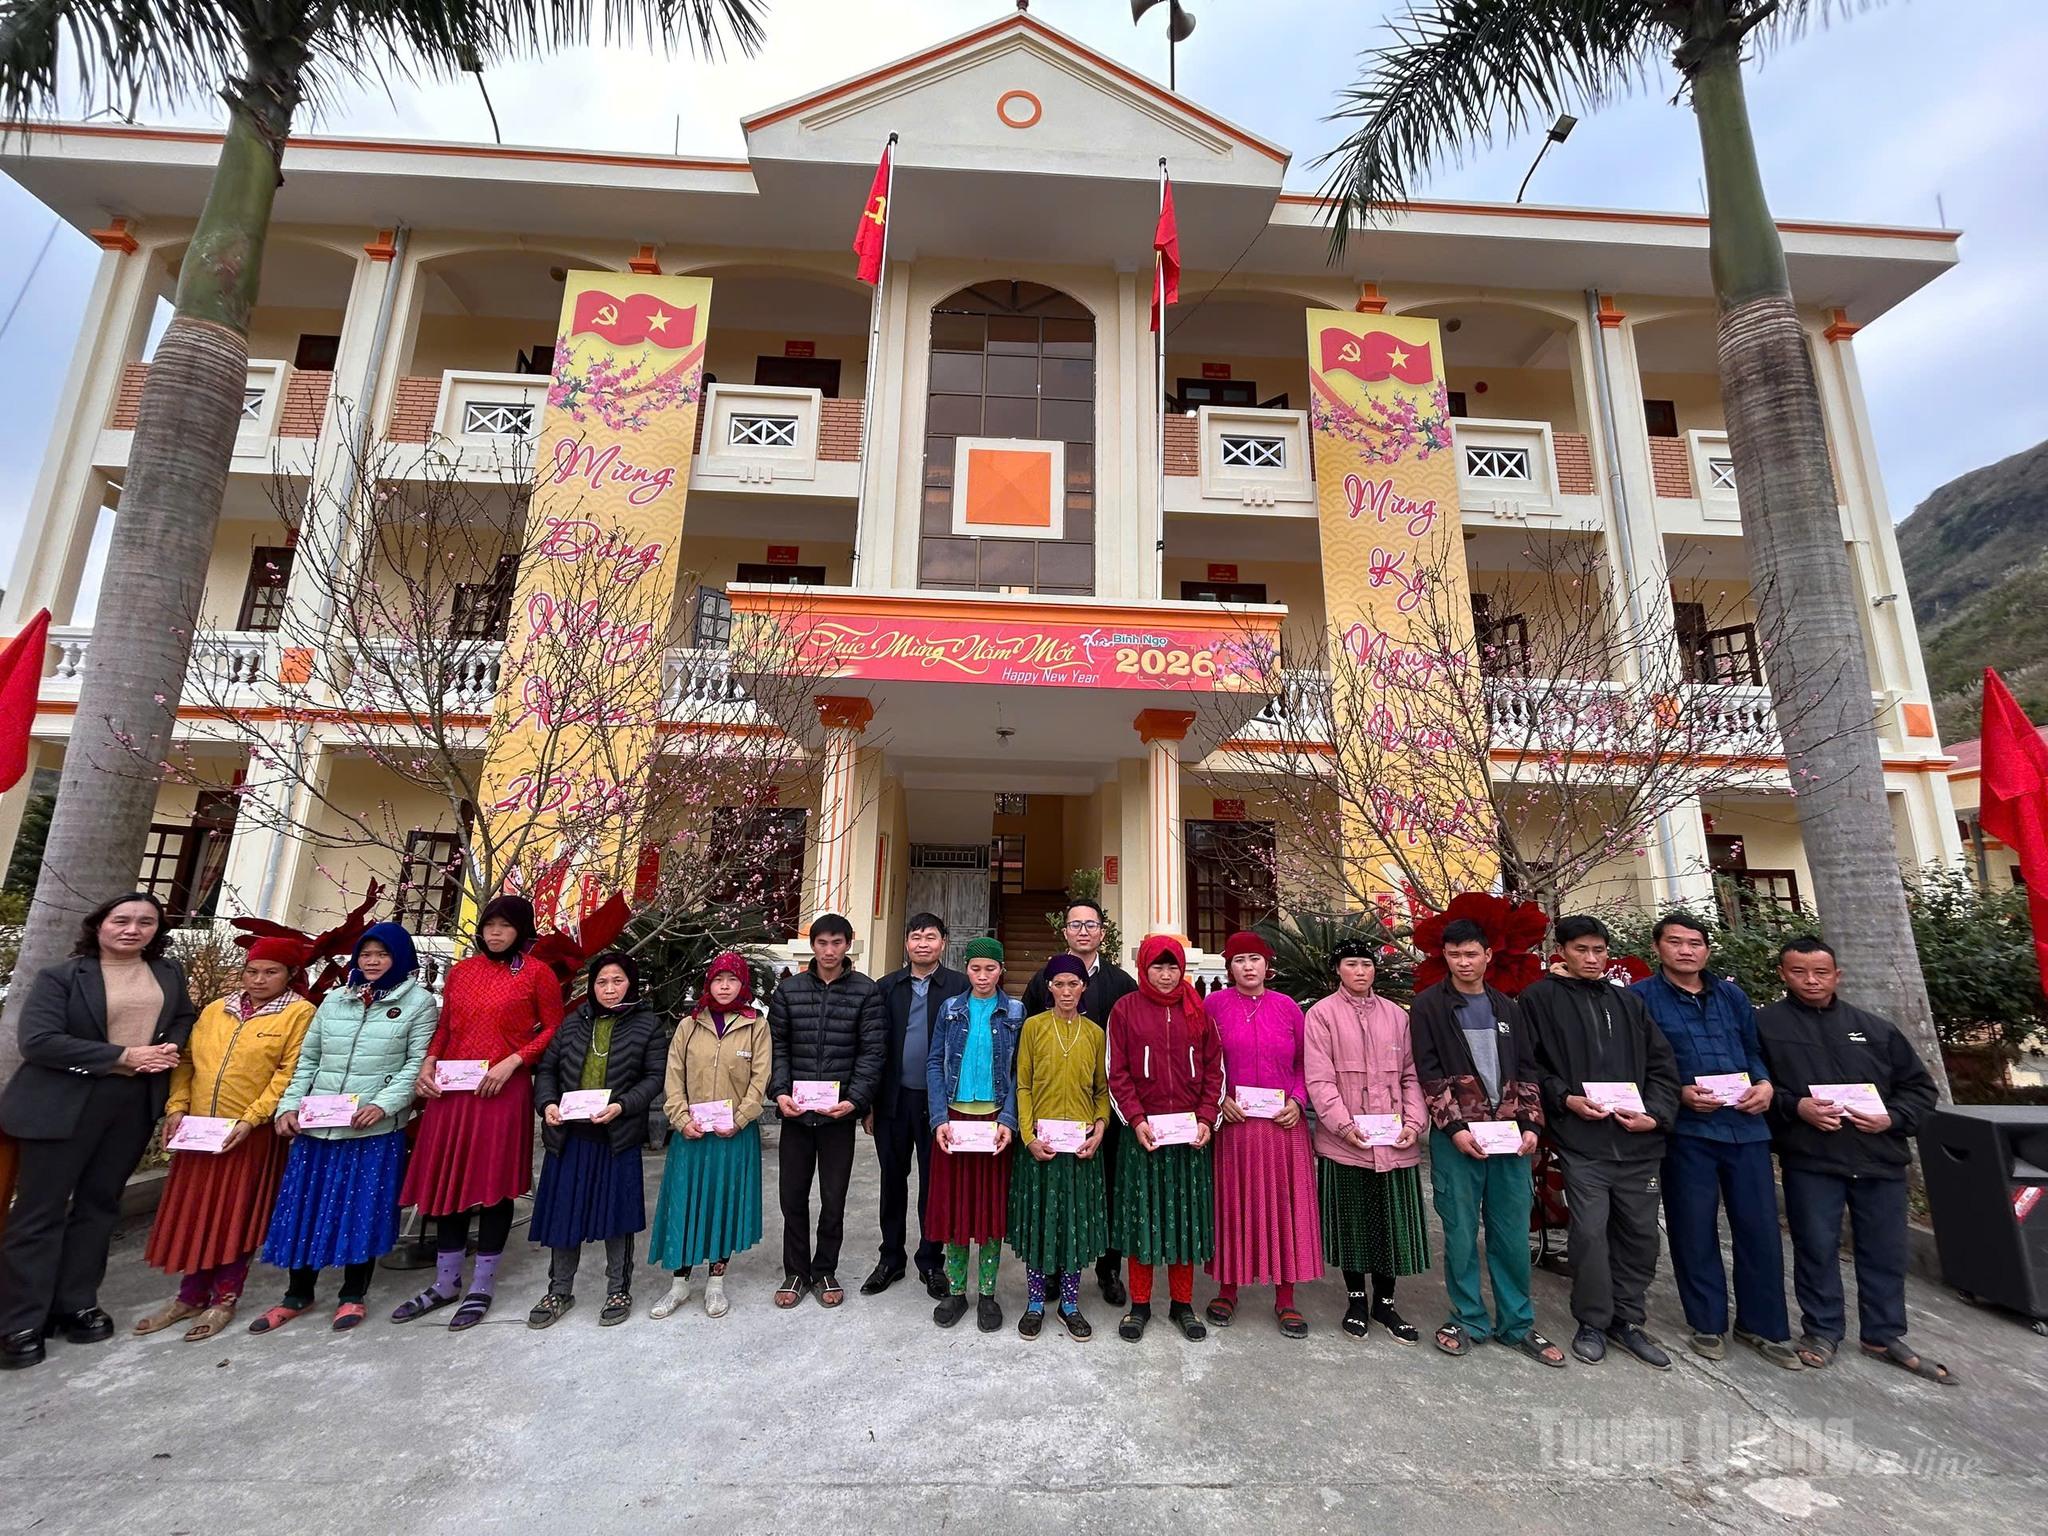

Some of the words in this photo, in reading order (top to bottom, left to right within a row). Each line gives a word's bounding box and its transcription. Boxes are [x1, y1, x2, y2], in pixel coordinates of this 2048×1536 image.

[555, 438, 675, 505] Mừng
[1344, 474, 1436, 536] Mừng
[871, 630, 970, 674] Mừng
[930, 631, 1014, 661] Năm
[1003, 633, 1084, 667] Mới
[1116, 648, 1217, 677] 2026
[1002, 667, 1039, 684] Happy
[1042, 669, 1067, 683] New
[1072, 669, 1099, 683] Year
